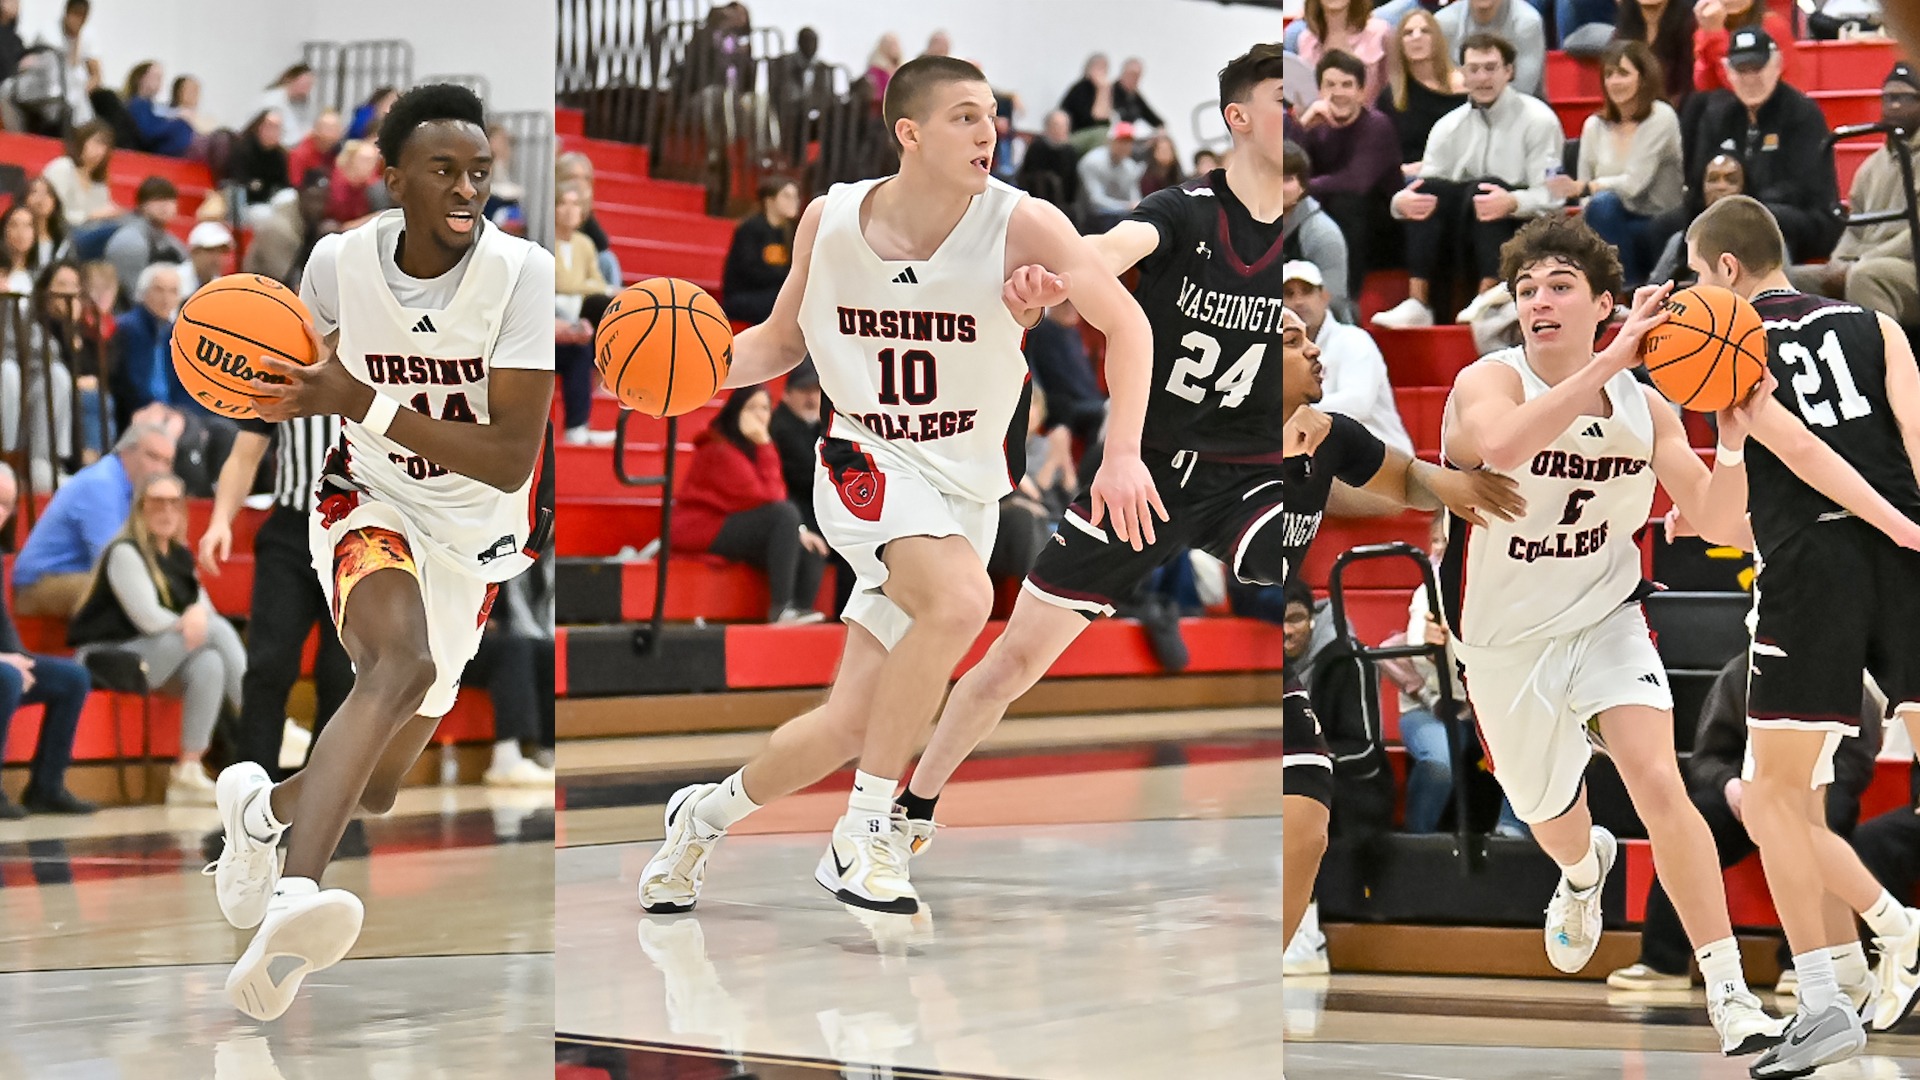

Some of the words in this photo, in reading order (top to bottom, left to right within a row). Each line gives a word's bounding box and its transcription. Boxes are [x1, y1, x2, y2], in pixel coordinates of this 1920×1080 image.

[836, 306, 977, 343] URSINUS
[877, 347, 937, 406] 10
[1164, 330, 1268, 409] 24
[1778, 329, 1873, 427] 21
